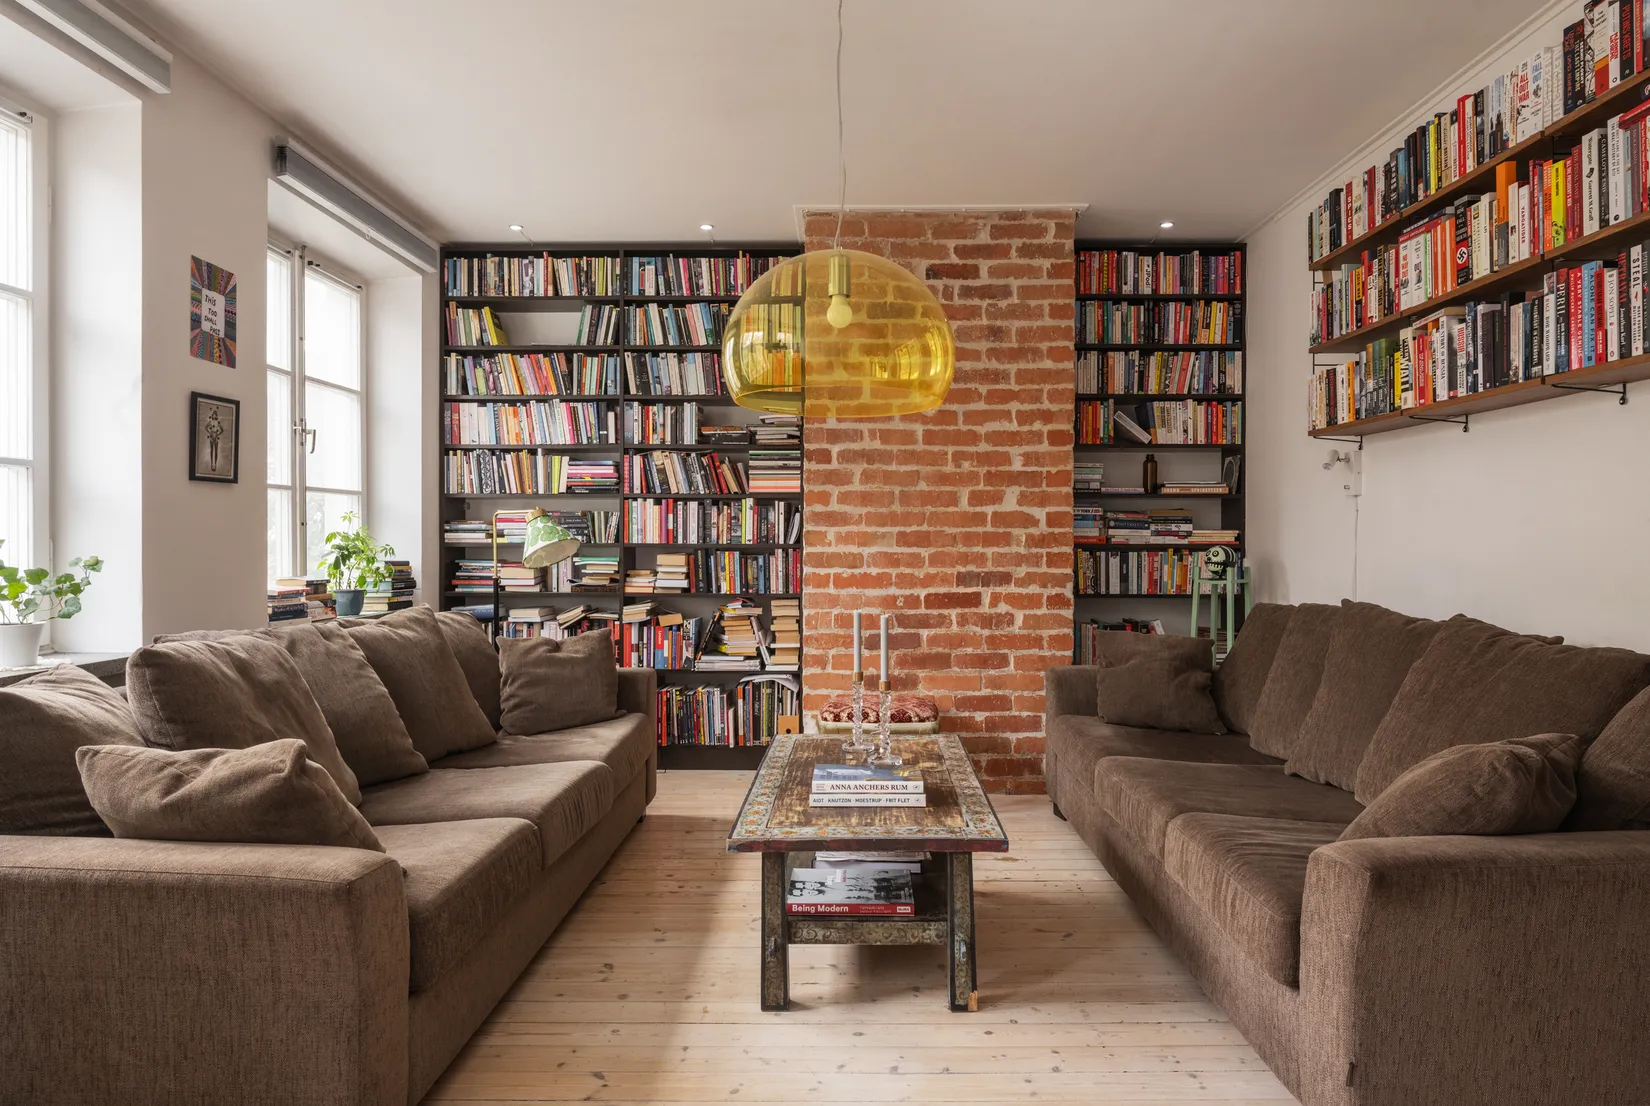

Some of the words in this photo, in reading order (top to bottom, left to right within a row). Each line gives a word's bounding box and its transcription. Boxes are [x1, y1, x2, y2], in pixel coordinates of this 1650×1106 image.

[1622, 4, 1631, 35] PUTINS
[1622, 33, 1631, 60] KRETS
[1532, 62, 1542, 74] FALL
[1520, 72, 1528, 84] ALL
[1519, 81, 1528, 94] OUT
[1518, 90, 1529, 104] WAR
[1556, 283, 1565, 318] PERIL
[208, 308, 217, 317] TOO
[204, 316, 217, 325] SHALL
[210, 326, 221, 336] PASS
[1590, 345, 1594, 353] IT
[1401, 358, 1409, 390] WALL
[792, 904, 816, 913] Being
